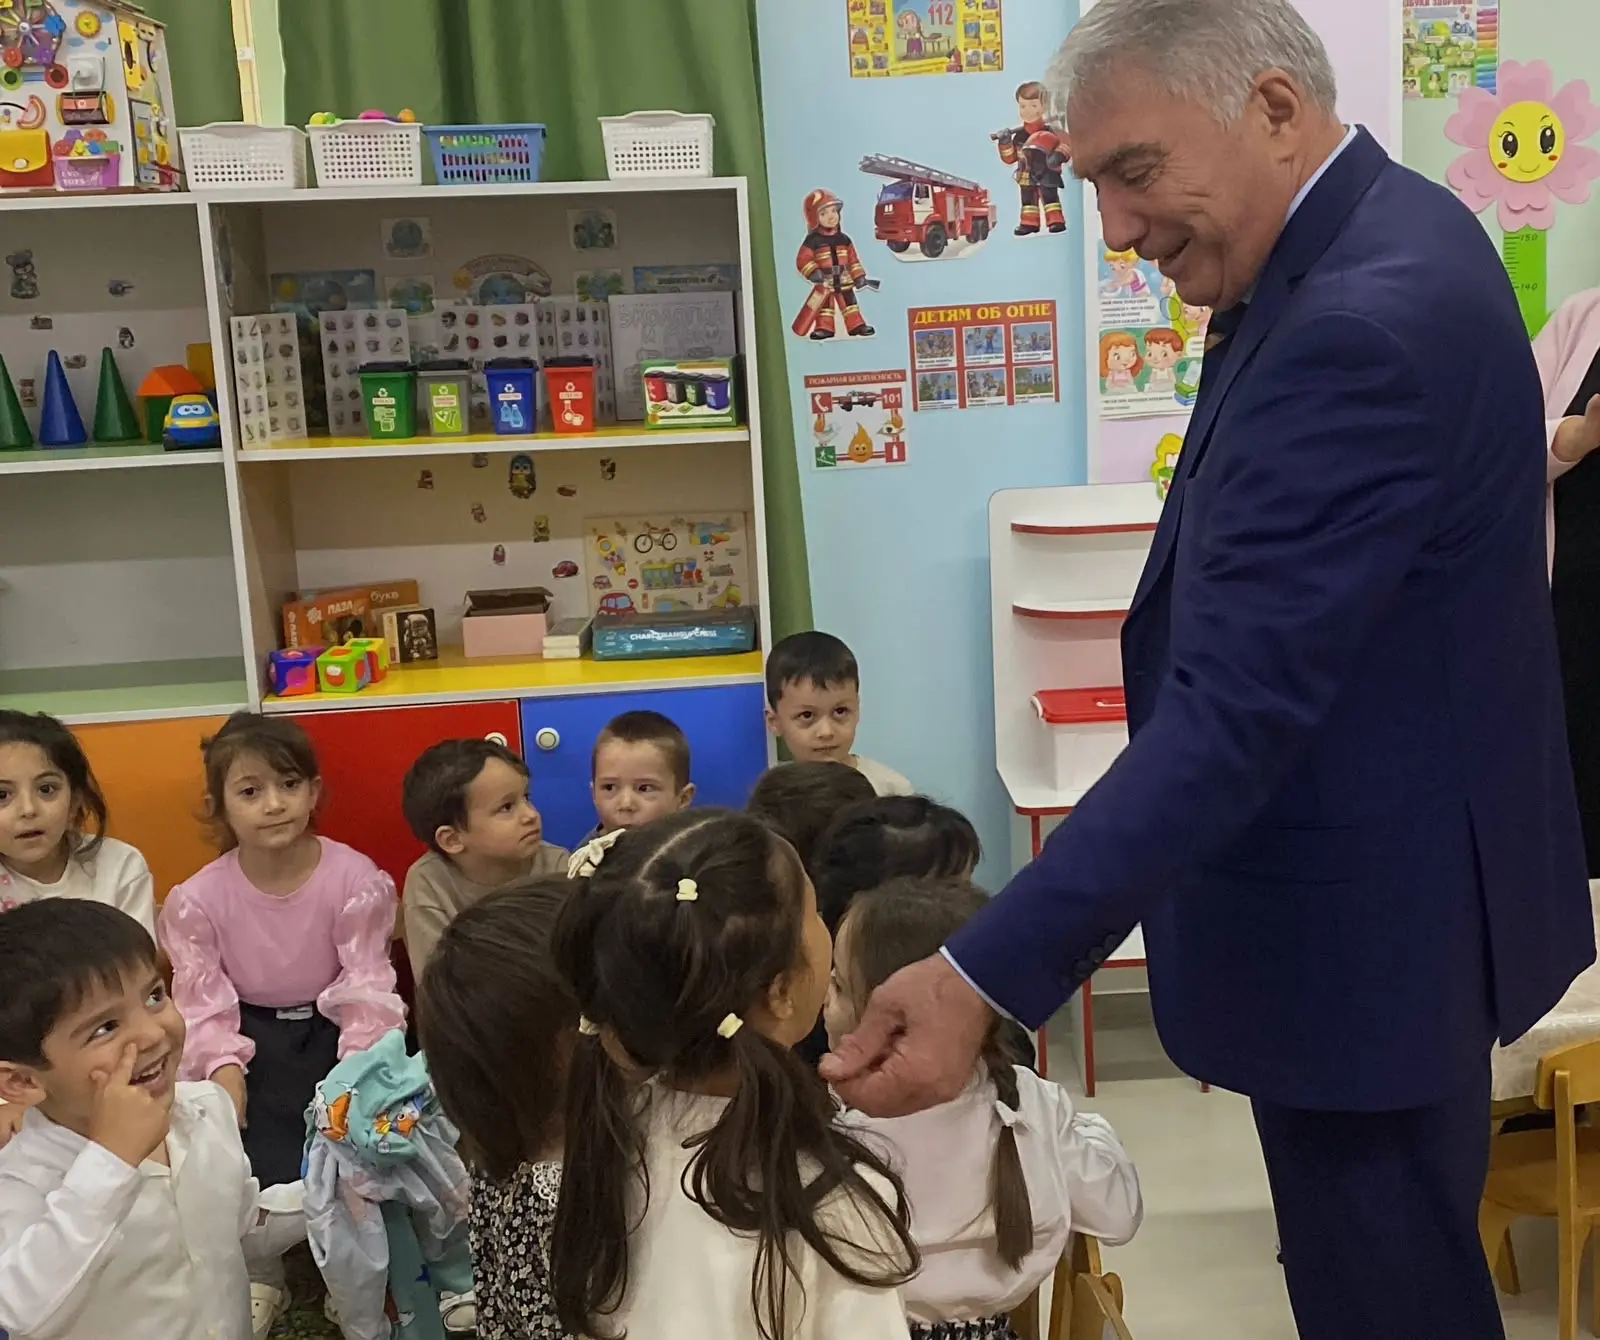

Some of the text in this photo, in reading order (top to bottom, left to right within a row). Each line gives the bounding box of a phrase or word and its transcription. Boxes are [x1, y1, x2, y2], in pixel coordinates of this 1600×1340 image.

[928, 3, 954, 25] 112
[1520, 282, 1538, 291] 140
[914, 303, 1052, 325] ДЕТЯМ ОБ ОГНЕ
[808, 376, 848, 385] ПОЖАРНАЯ
[883, 393, 901, 405] 101
